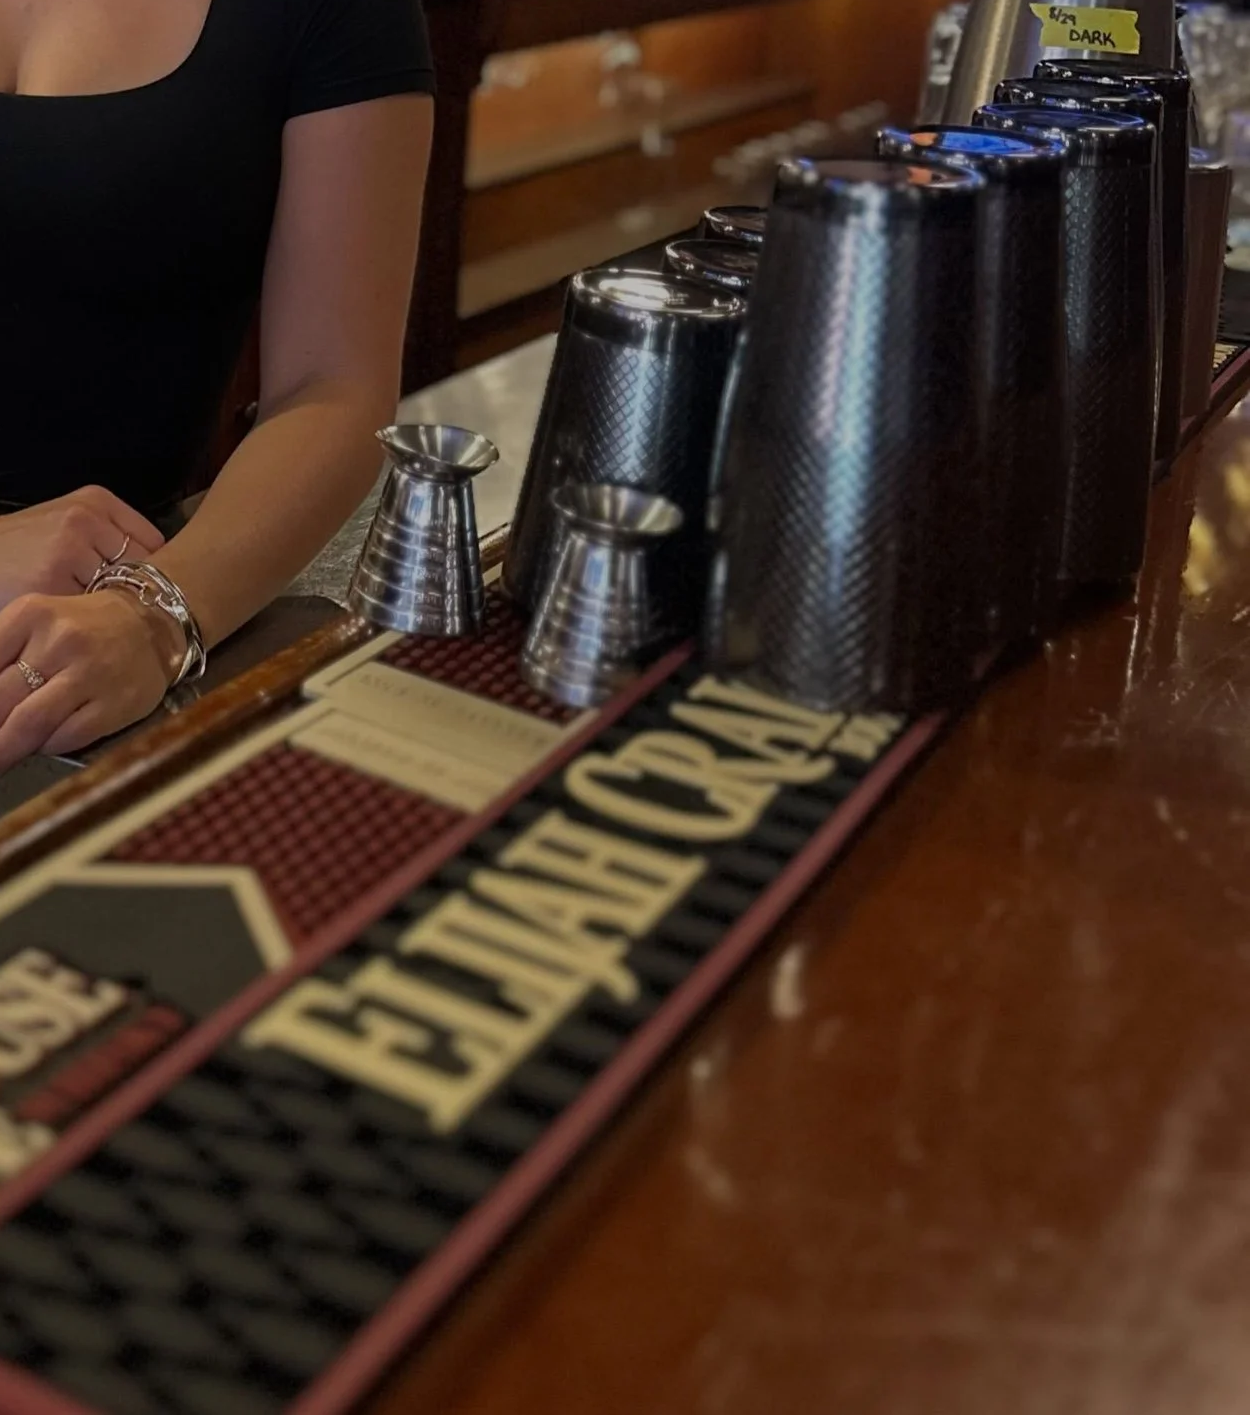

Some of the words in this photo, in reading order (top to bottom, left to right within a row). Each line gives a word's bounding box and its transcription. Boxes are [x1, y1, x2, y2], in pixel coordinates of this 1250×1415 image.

[1069, 29, 1117, 49] DARK
[244, 806, 708, 1135] ELIJAH
[563, 674, 848, 844] CRAI
